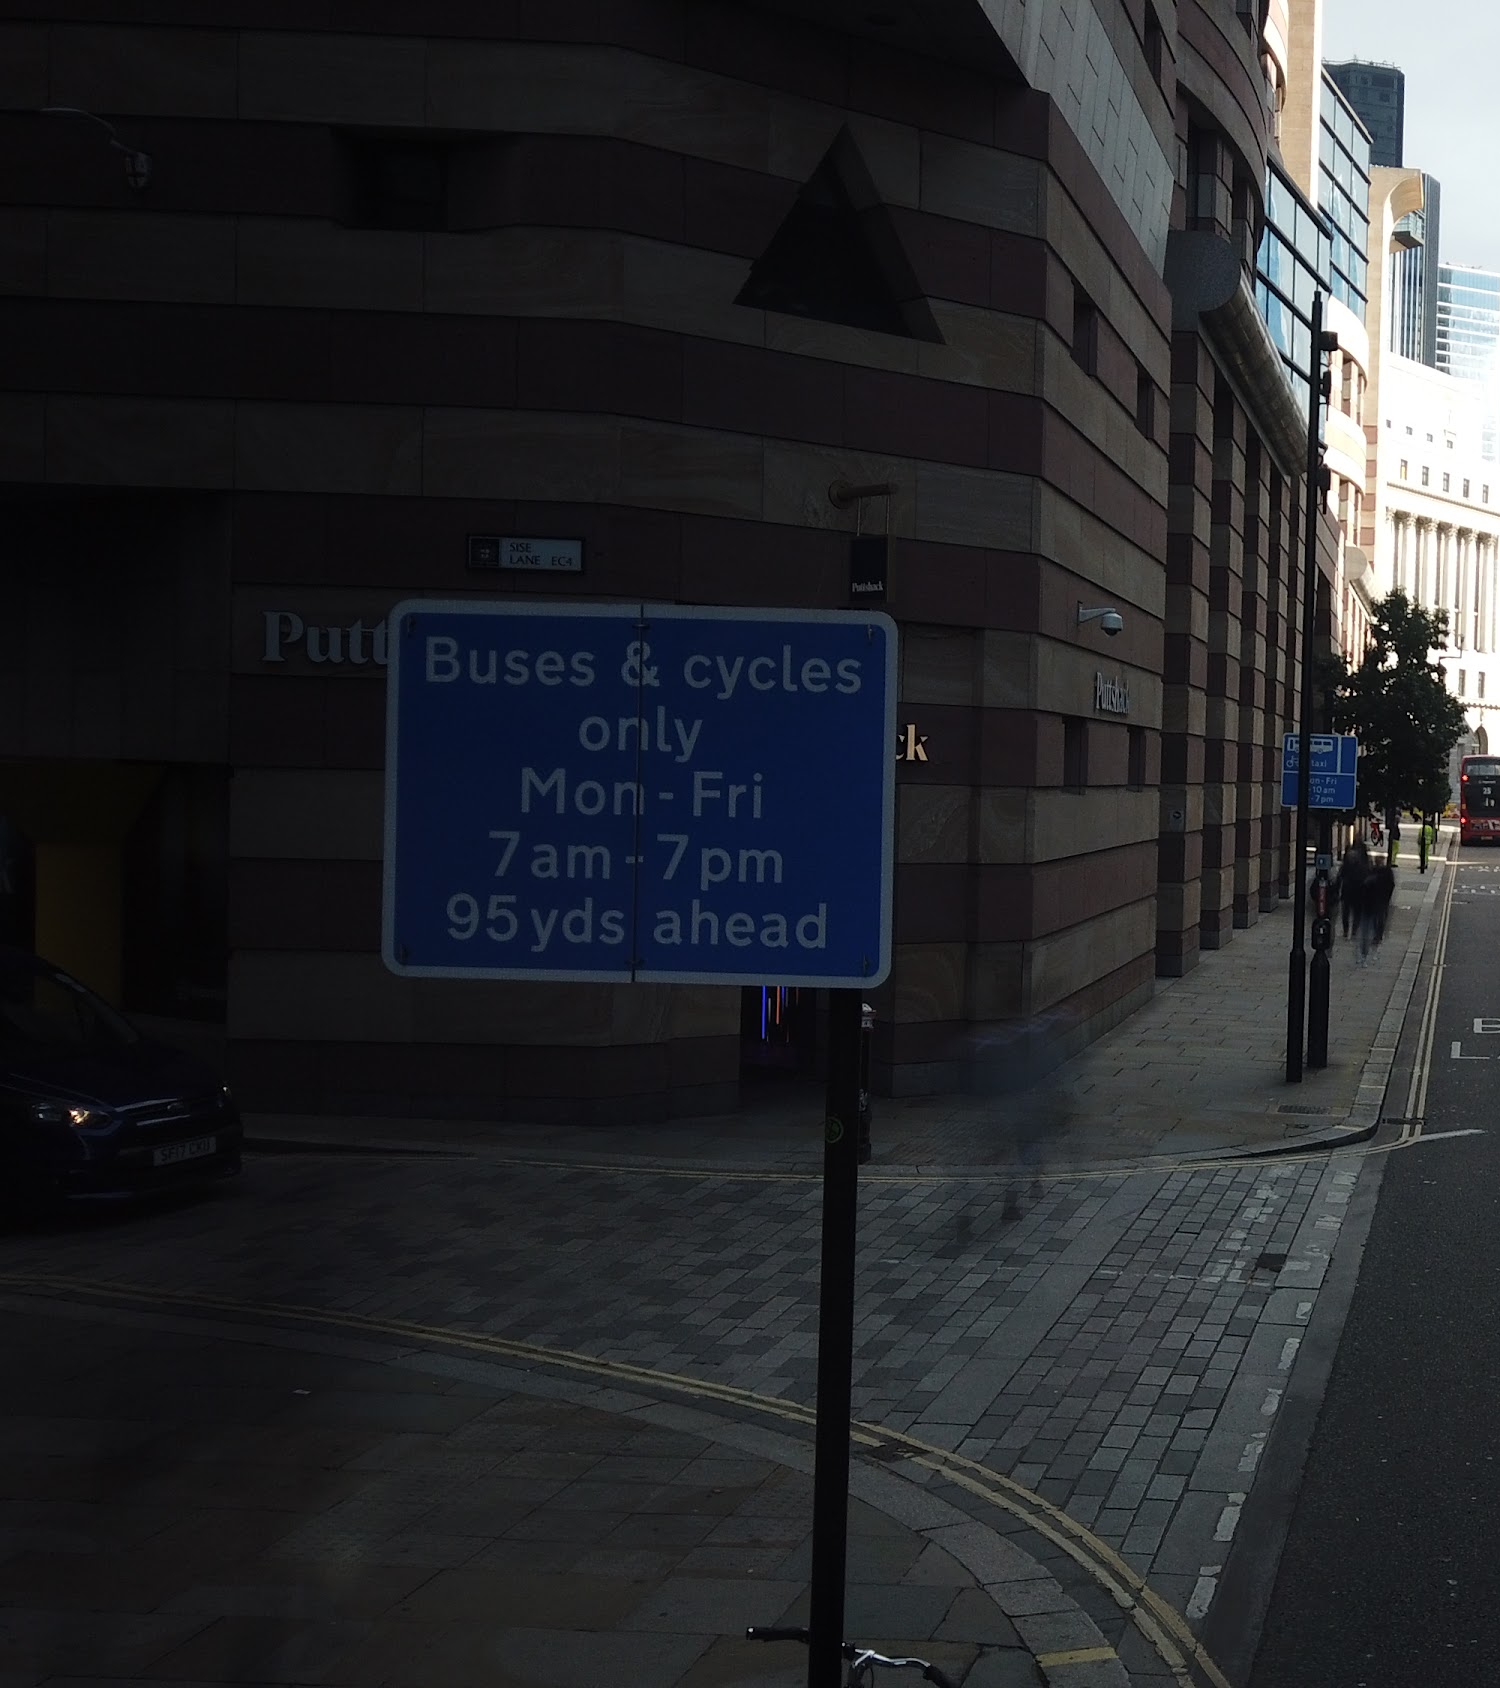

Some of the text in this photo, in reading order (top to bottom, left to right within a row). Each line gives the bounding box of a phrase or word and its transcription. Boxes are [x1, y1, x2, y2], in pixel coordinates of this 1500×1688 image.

[509, 542, 532, 553] SISE
[509, 555, 573, 566] LANE EC4
[425, 636, 862, 700] Buses & cycles
[578, 706, 704, 763] only
[1311, 760, 1327, 768] taxi
[653, 899, 828, 950] ahead
